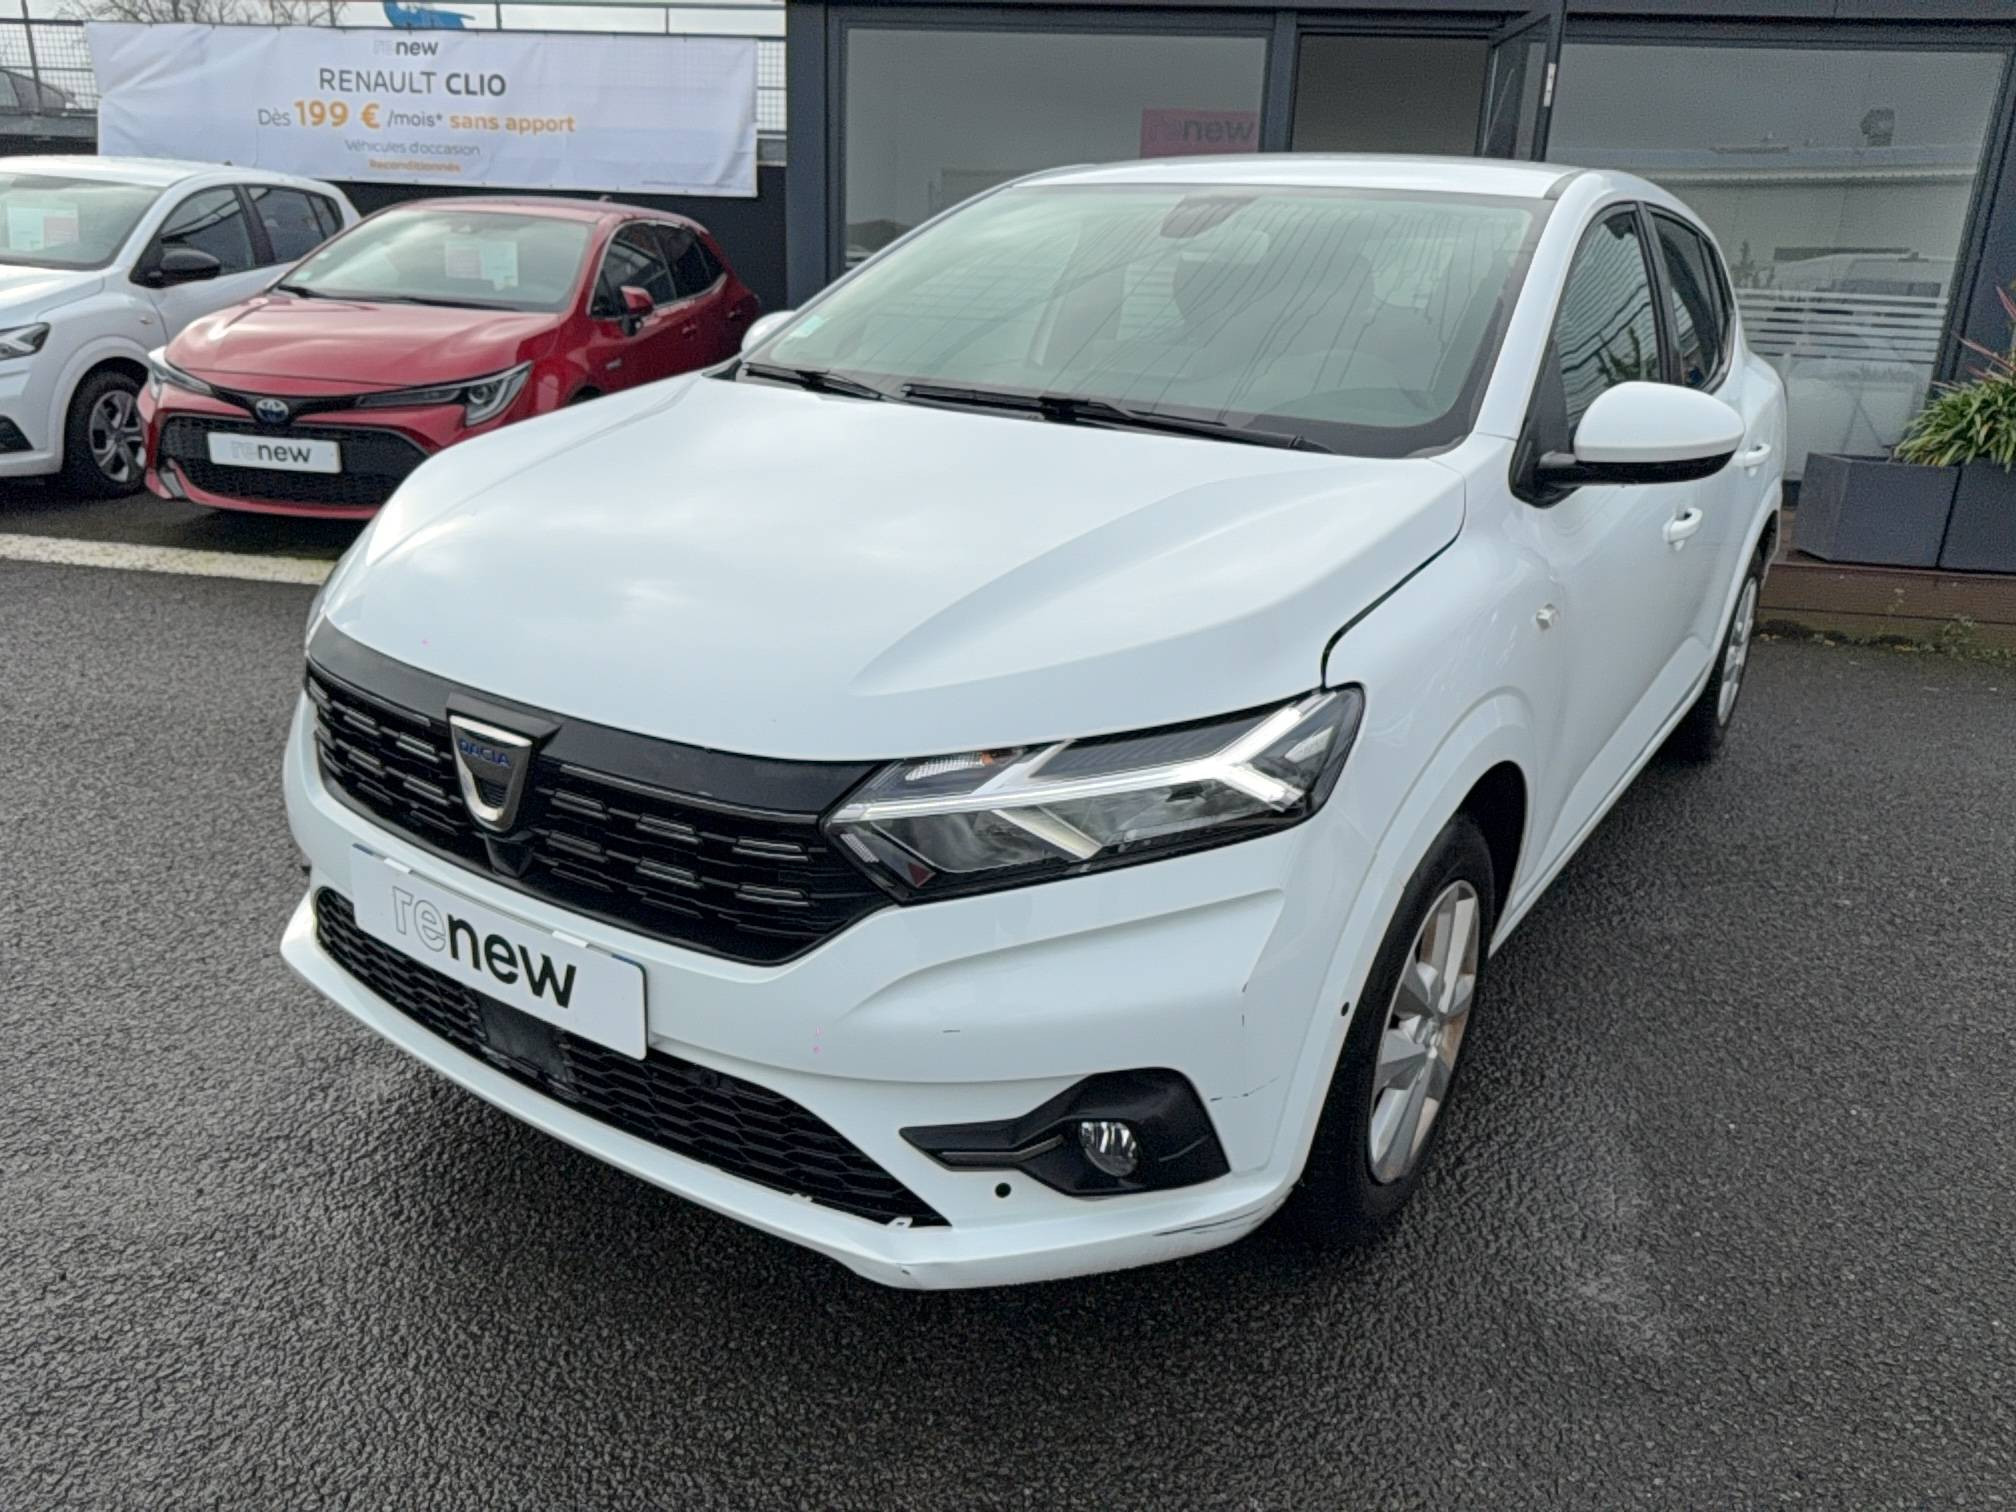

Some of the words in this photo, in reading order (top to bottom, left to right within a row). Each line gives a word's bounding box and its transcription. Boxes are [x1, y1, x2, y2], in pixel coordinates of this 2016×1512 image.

[319, 67, 437, 95] RENAULT
[445, 72, 506, 97] CLIO
[257, 107, 292, 127] Dès
[294, 100, 349, 127] 199
[361, 102, 380, 129] €
[450, 114, 499, 130] sans
[505, 115, 576, 135] apport
[231, 440, 312, 464] renew
[458, 737, 512, 768] DACIA
[391, 886, 576, 1009] renew
